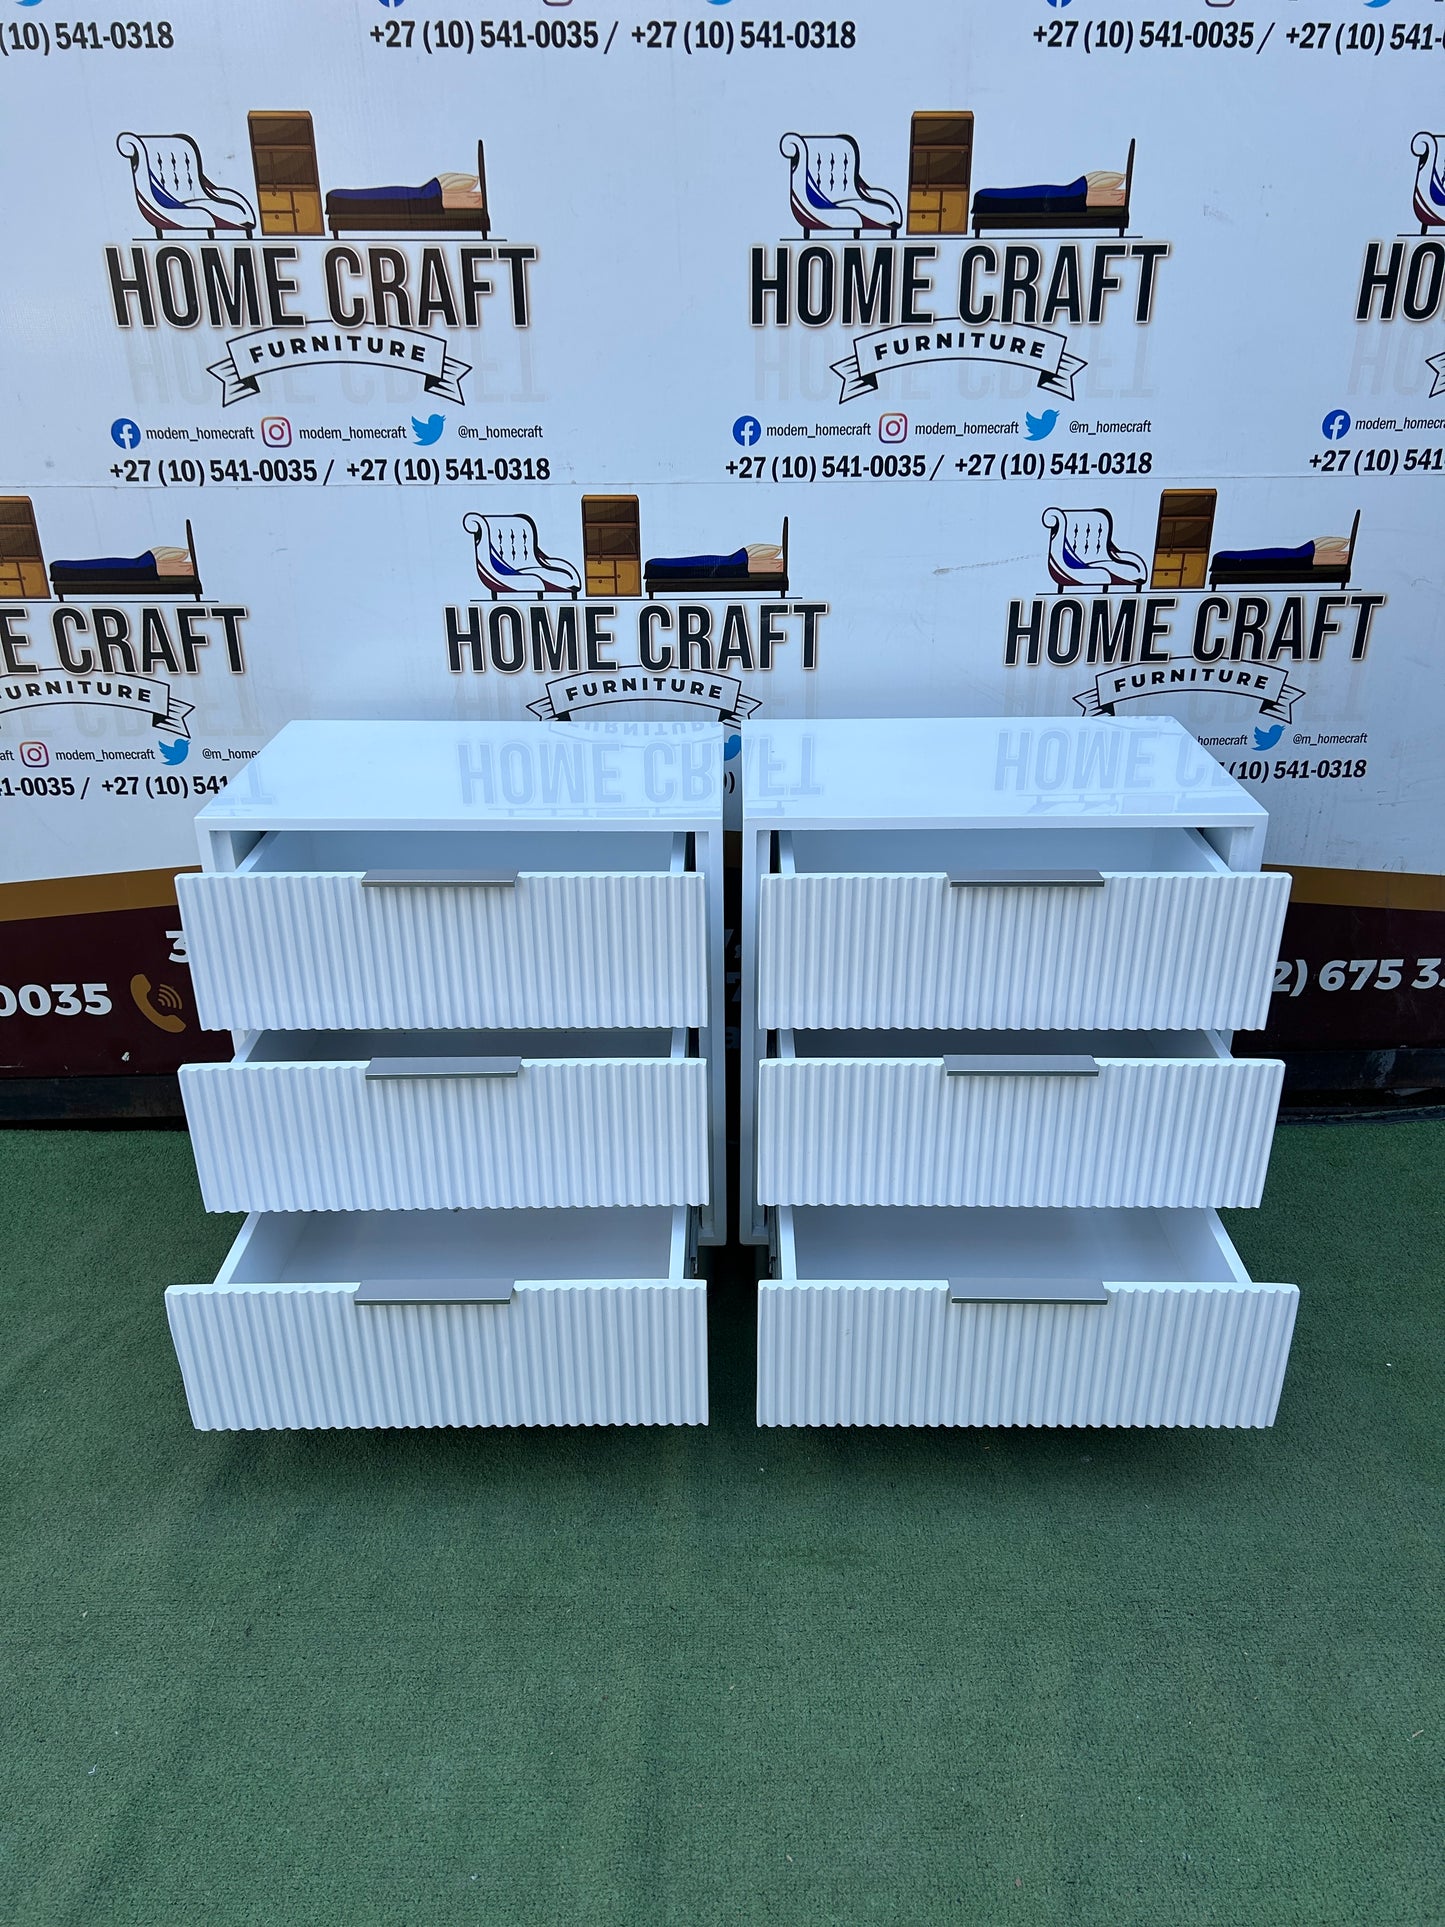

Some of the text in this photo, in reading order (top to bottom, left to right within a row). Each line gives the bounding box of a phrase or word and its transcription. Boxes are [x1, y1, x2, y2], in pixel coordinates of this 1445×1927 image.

[55, 22, 174, 49] 541-0318
[370, 20, 415, 48] +27
[423, 20, 474, 54] (10)
[481, 20, 598, 48] 541-0035
[632, 21, 677, 48] +27
[684, 21, 734, 54] (10)
[740, 21, 855, 48] 541-0318
[1033, 20, 1079, 47] +27
[1084, 21, 1133, 54] (10)
[1139, 21, 1254, 48] 541-0035
[1286, 23, 1331, 49] +27
[1336, 23, 1384, 56] (10)
[105, 245, 537, 328] HOME CRAFT
[749, 241, 1170, 328] HOME CRAFT
[249, 335, 426, 364] FURNITURE
[874, 332, 1046, 361] FURNITURE
[458, 425, 543, 440] @m_homecraft
[1070, 420, 1151, 435] @m_homecraft
[110, 460, 150, 481] +27
[159, 460, 204, 487] (10)
[210, 459, 317, 482] 541-0035
[347, 459, 387, 480] +27
[394, 459, 439, 486] (10)
[446, 458, 550, 480] 541-0318
[726, 457, 766, 478] +27
[772, 456, 816, 483] (10)
[822, 455, 926, 478] 541-0035
[955, 454, 996, 476] +27
[1001, 453, 1045, 480] (10)
[1050, 452, 1152, 475] 541-0318
[1310, 450, 1351, 471] +27
[1354, 449, 1398, 474] (10)
[51, 607, 247, 675] CRAFT
[444, 602, 829, 673] HOME CRAFT
[1004, 594, 1386, 666] HOME CRAFT
[0, 680, 151, 703] URNITURE
[566, 677, 723, 702] FURNITURE
[1114, 668, 1269, 694] FURNITURE
[1293, 733, 1367, 746] @m_homecraft
[1274, 760, 1366, 779] 541-0318
[0, 777, 75, 796] 1-0035
[102, 777, 138, 795] +27
[146, 776, 188, 799] (10)
[1319, 959, 1403, 991] 675
